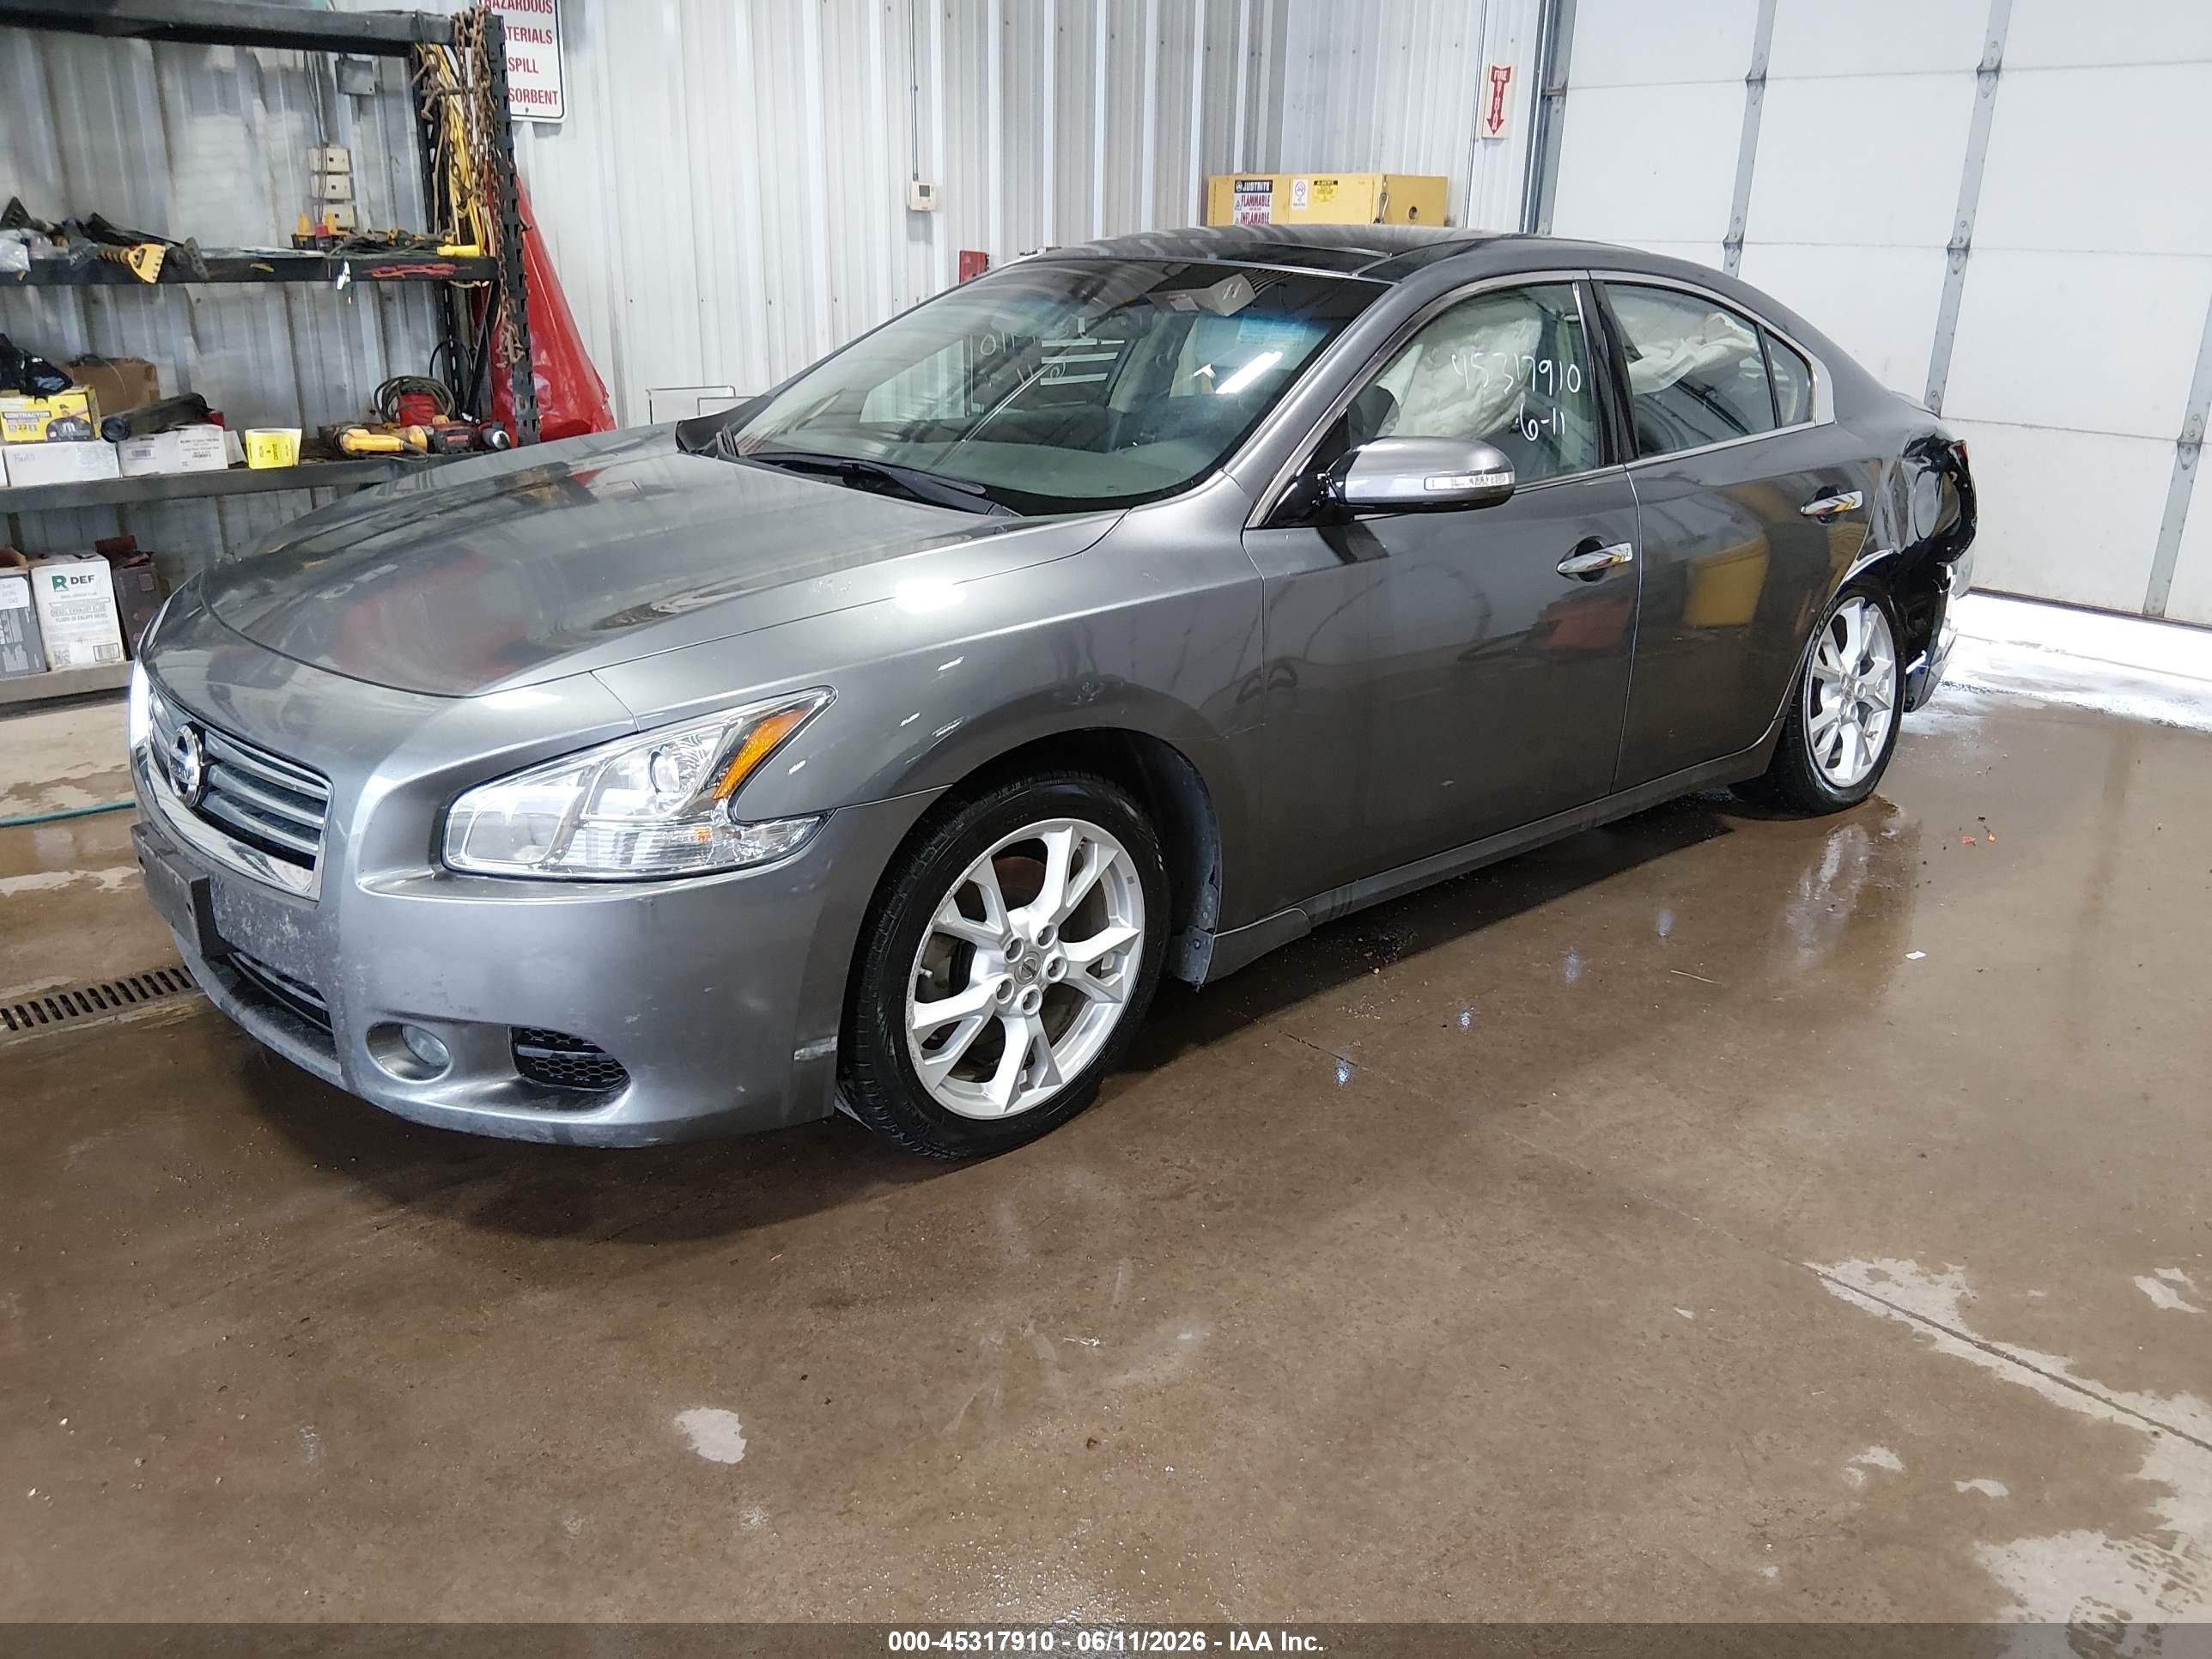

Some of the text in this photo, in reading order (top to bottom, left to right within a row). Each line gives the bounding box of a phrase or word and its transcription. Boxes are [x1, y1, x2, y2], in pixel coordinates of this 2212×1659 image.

[505, 27, 553, 45] TERIALS
[507, 57, 539, 74] SPILL
[508, 88, 558, 105] SORBENT
[1241, 194, 1271, 207] FLAMMABLE
[1451, 352, 1581, 397] 45317910
[70, 575, 95, 585] DEF
